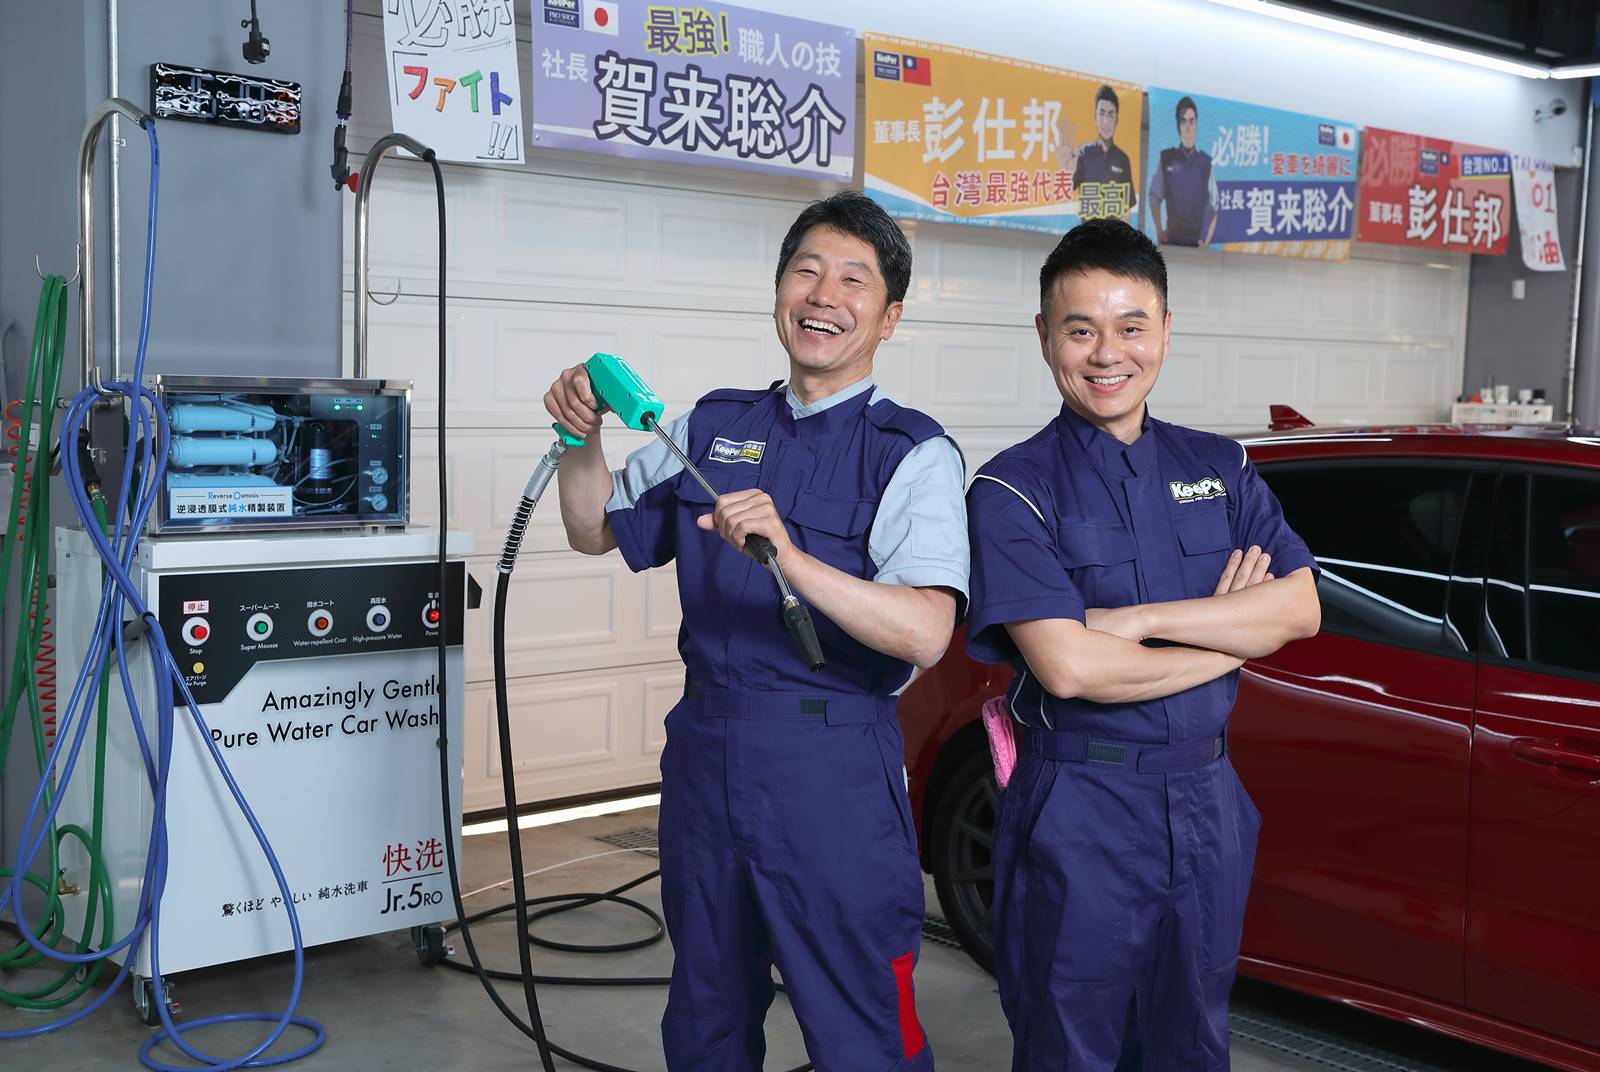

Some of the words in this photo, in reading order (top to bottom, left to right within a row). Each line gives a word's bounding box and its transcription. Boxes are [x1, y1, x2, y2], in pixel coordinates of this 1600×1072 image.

[645, 7, 731, 57] 最強!
[738, 27, 842, 78] 職人の技
[541, 48, 589, 83] 社長
[594, 51, 846, 167] 賀来聡介
[874, 119, 921, 145] 董事長
[922, 97, 1063, 163] 彭仕邦
[1211, 125, 1270, 167] 必勝!
[931, 171, 1074, 208] 台灣最強代表
[1219, 189, 1245, 211] 社長
[1246, 186, 1354, 236] 賀来聡介
[1406, 183, 1503, 249] 彭仕邦
[176, 503, 286, 514] 逆浸透膜式純水精製装置
[208, 491, 233, 500] Reverse
[233, 491, 260, 500] Osmosis
[240, 603, 280, 612] スーパームース
[262, 681, 375, 712] Amazingly
[211, 728, 258, 748] Pure
[267, 721, 333, 743] Water
[341, 714, 378, 735] Car
[385, 705, 439, 729] Wash
[383, 838, 444, 877] 快洗
[318, 880, 368, 900] 純水洗車
